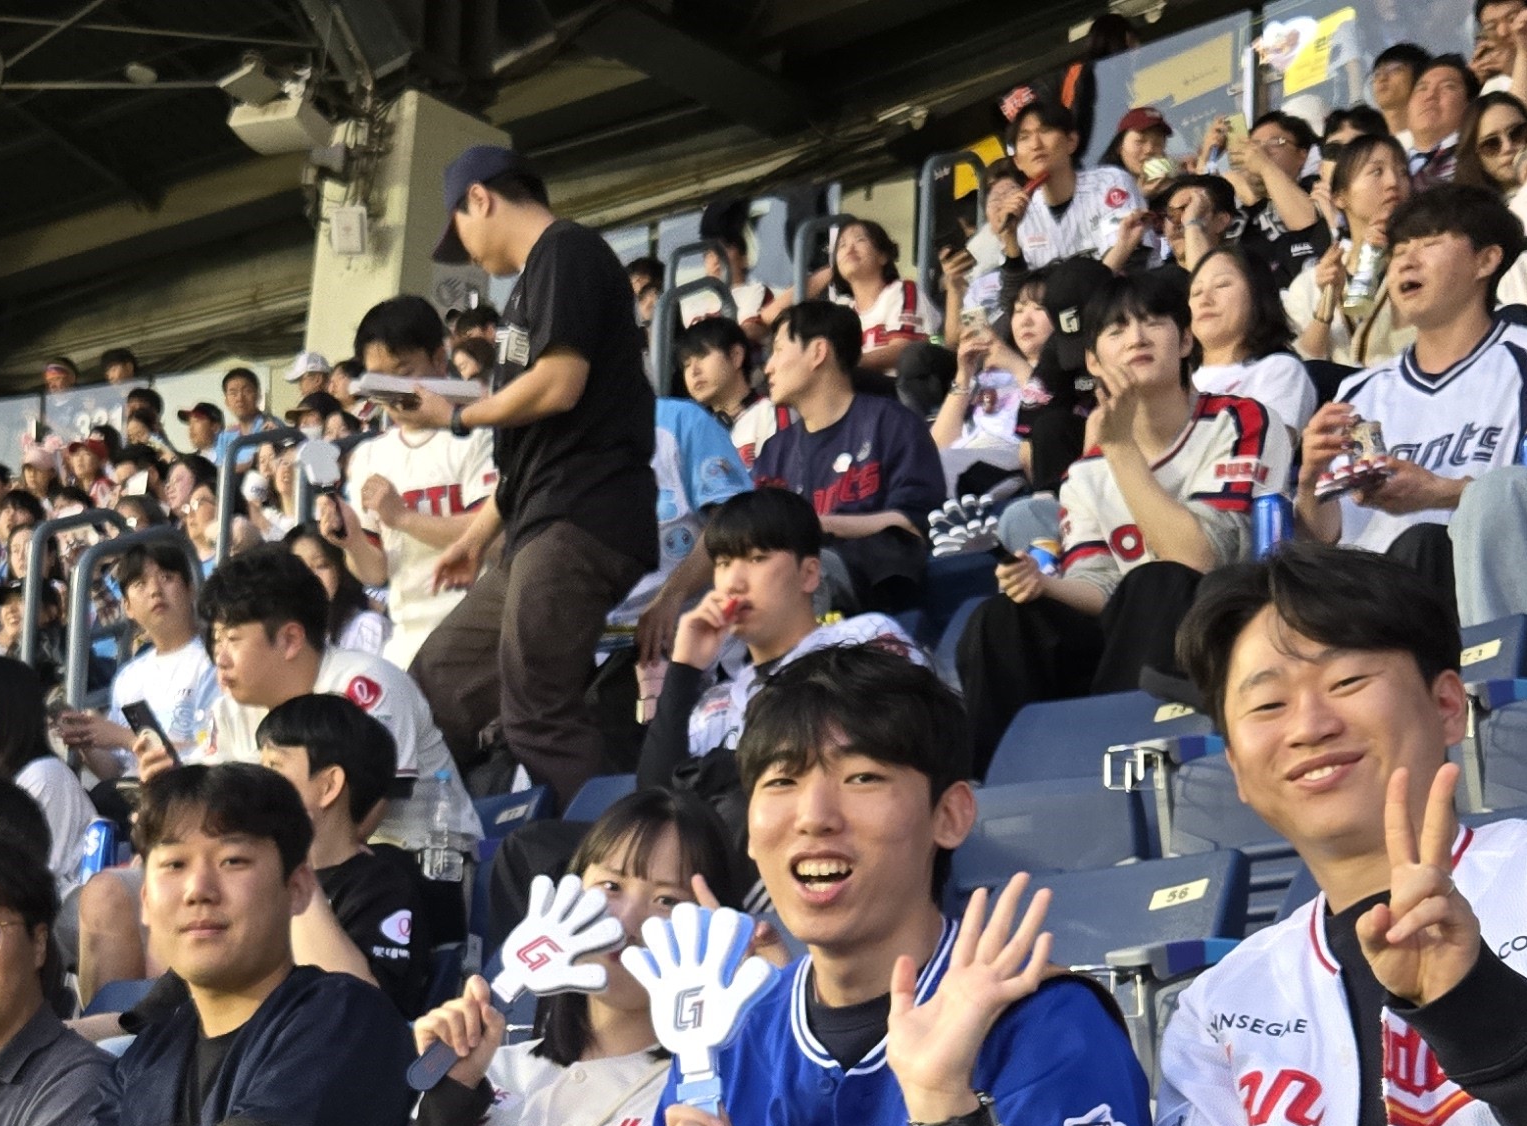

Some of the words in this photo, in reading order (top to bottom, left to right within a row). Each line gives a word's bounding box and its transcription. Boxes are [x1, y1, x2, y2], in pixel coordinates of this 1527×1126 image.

[1165, 886, 1190, 903] 56
[516, 934, 565, 973] G
[673, 984, 706, 1033] G
